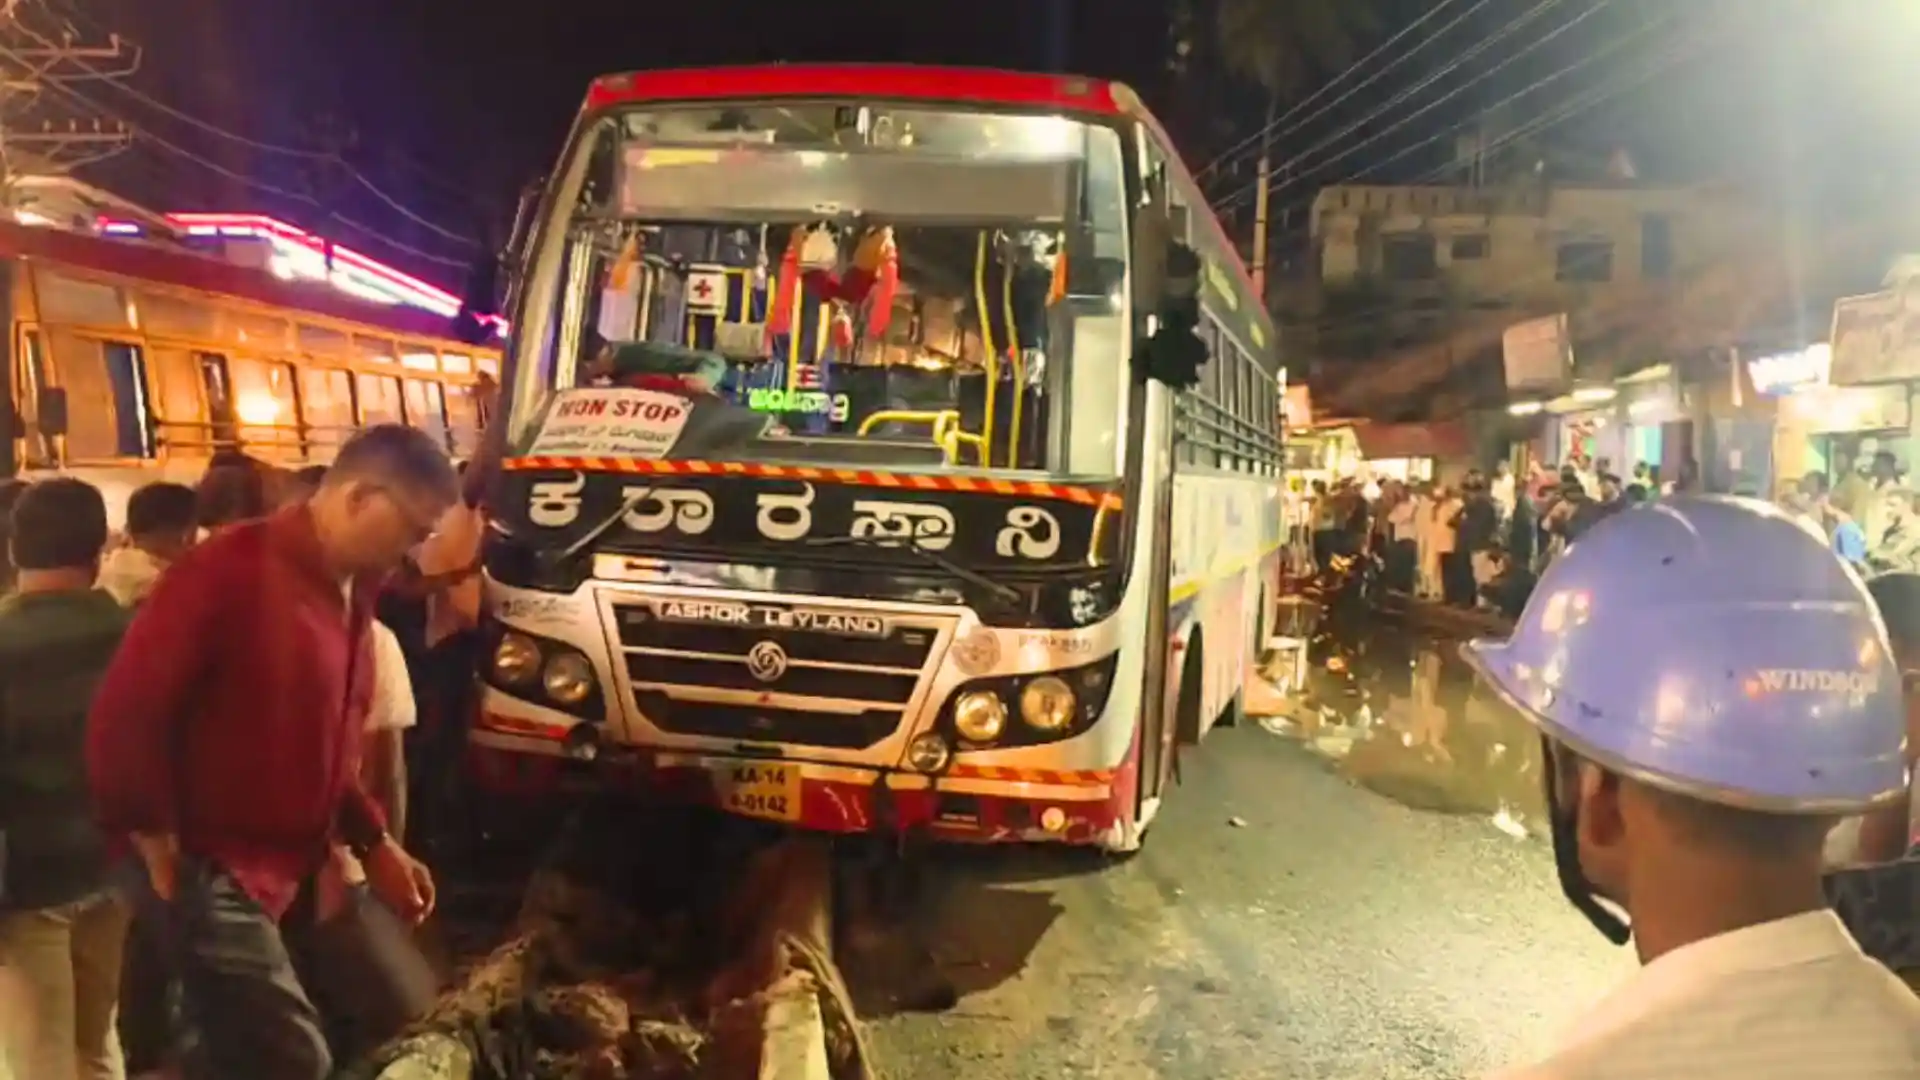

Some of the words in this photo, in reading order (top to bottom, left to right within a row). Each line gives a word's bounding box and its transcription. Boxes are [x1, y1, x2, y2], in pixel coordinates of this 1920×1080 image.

[556, 399, 607, 418] NON
[612, 399, 682, 422] STOP
[665, 602, 750, 623] ASHOK
[764, 607, 880, 632] LEYLAND
